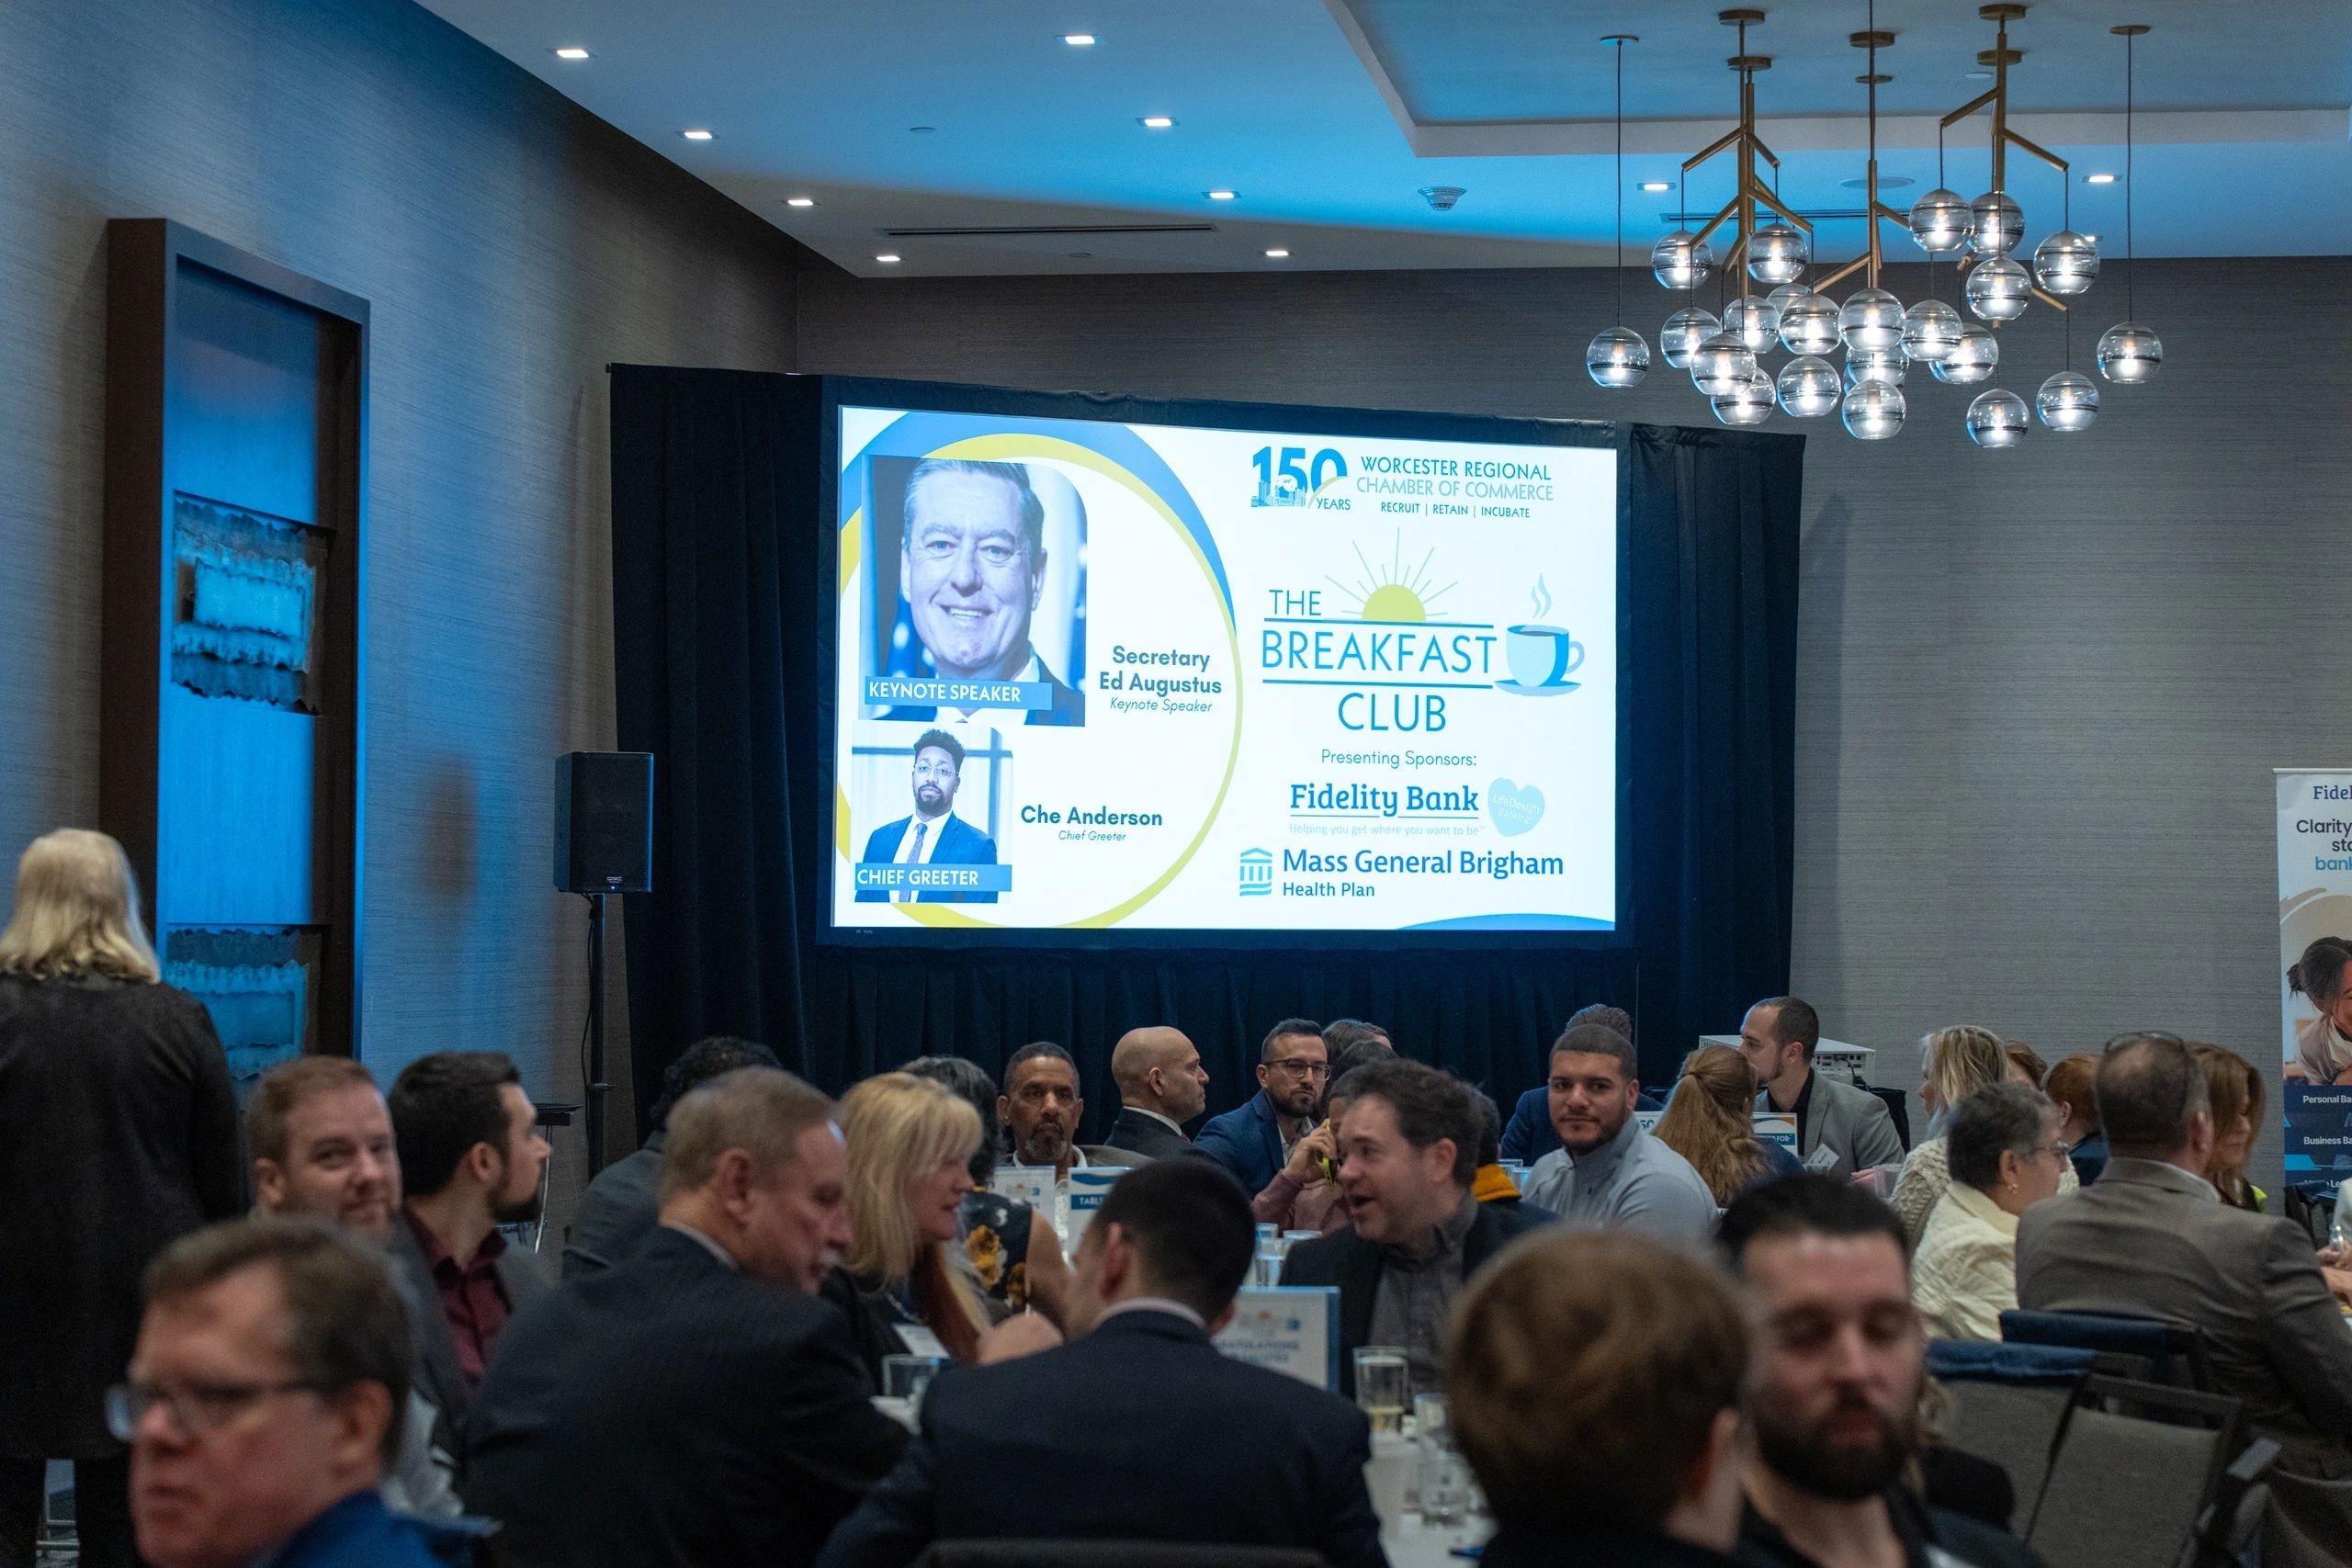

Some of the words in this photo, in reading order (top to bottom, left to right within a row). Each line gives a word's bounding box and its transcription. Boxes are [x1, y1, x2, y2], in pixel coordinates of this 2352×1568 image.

[1250, 446, 1348, 507] 150
[1361, 455, 1459, 476] WORCESTER
[1464, 461, 1552, 480] REGIONAL
[1356, 477, 1434, 496] CHAMBER
[1438, 480, 1461, 497] OF
[1464, 481, 1554, 501] COMMERCE
[1317, 498, 1351, 511] YEARS
[1381, 502, 1420, 514] RECRUIT
[1432, 504, 1468, 516] RETAIN
[1481, 506, 1531, 518] INCUBATE
[1269, 590, 1321, 616] THE
[1112, 646, 1210, 671] Secretary
[1261, 630, 1498, 674] BREAKFAST
[869, 682, 946, 701] KEYNOTE
[950, 683, 1021, 703] SPEAKER
[1100, 671, 1123, 691] Ed
[1129, 673, 1222, 698] Augustus
[1110, 697, 1159, 712] Keynote
[1162, 699, 1213, 716] Speaker
[1338, 693, 1447, 732] CLUB
[1321, 749, 1401, 770] Presenting
[1405, 750, 1478, 770] Sponsors:
[1290, 783, 1398, 818] Fidelity
[1406, 785, 1479, 812] Bank
[1492, 792, 1541, 816] LifeDesign
[1021, 805, 1061, 825] Che
[1068, 807, 1163, 827] Anderson
[1498, 805, 1531, 825] Banking
[1058, 829, 1085, 841] Chief
[1088, 830, 1126, 842] Greeter
[1289, 823, 1328, 837] Helping
[1330, 827, 1349, 837] you
[1351, 826, 1367, 837] get
[1370, 825, 1402, 835] where
[1405, 828, 1423, 837] you
[1426, 826, 1451, 836] want
[1453, 826, 1465, 836] to
[2296, 818, 2352, 838] Clarity
[1283, 848, 1348, 874] Mass
[1354, 850, 1453, 875] General
[1460, 852, 1564, 880] Brigham
[857, 869, 905, 886] CHIEF
[909, 869, 979, 886] GREETER
[1283, 882, 1337, 897] Health
[1341, 882, 1375, 897] Plan
[2302, 1095, 2340, 1104] Personal
[2303, 1135, 2342, 1145] Business
